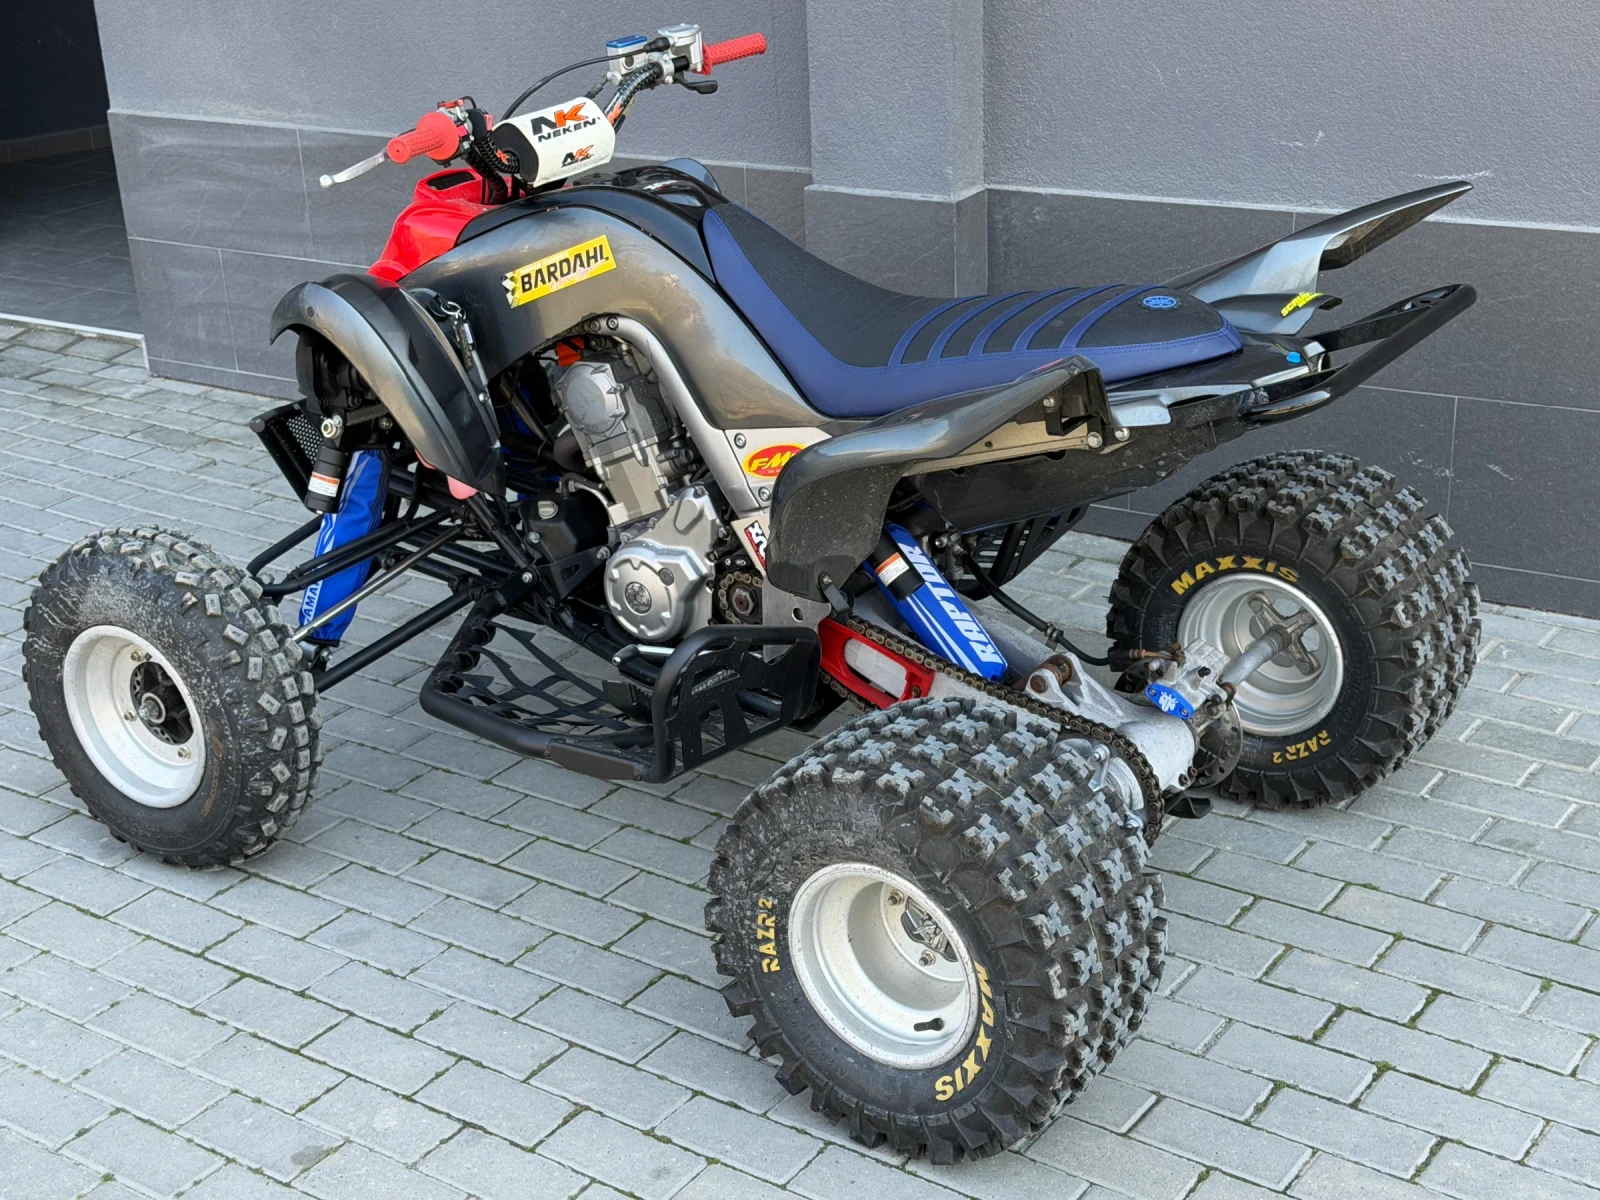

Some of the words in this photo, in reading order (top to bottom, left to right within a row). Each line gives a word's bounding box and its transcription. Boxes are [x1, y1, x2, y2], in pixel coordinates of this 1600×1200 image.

[538, 118, 597, 142] NEKEN
[520, 244, 609, 293] BARDAHL
[749, 451, 796, 472] FM
[1170, 554, 1300, 596] MAXXIS
[898, 542, 1004, 665] RAPTOR
[934, 960, 995, 1101] MAXXIS
